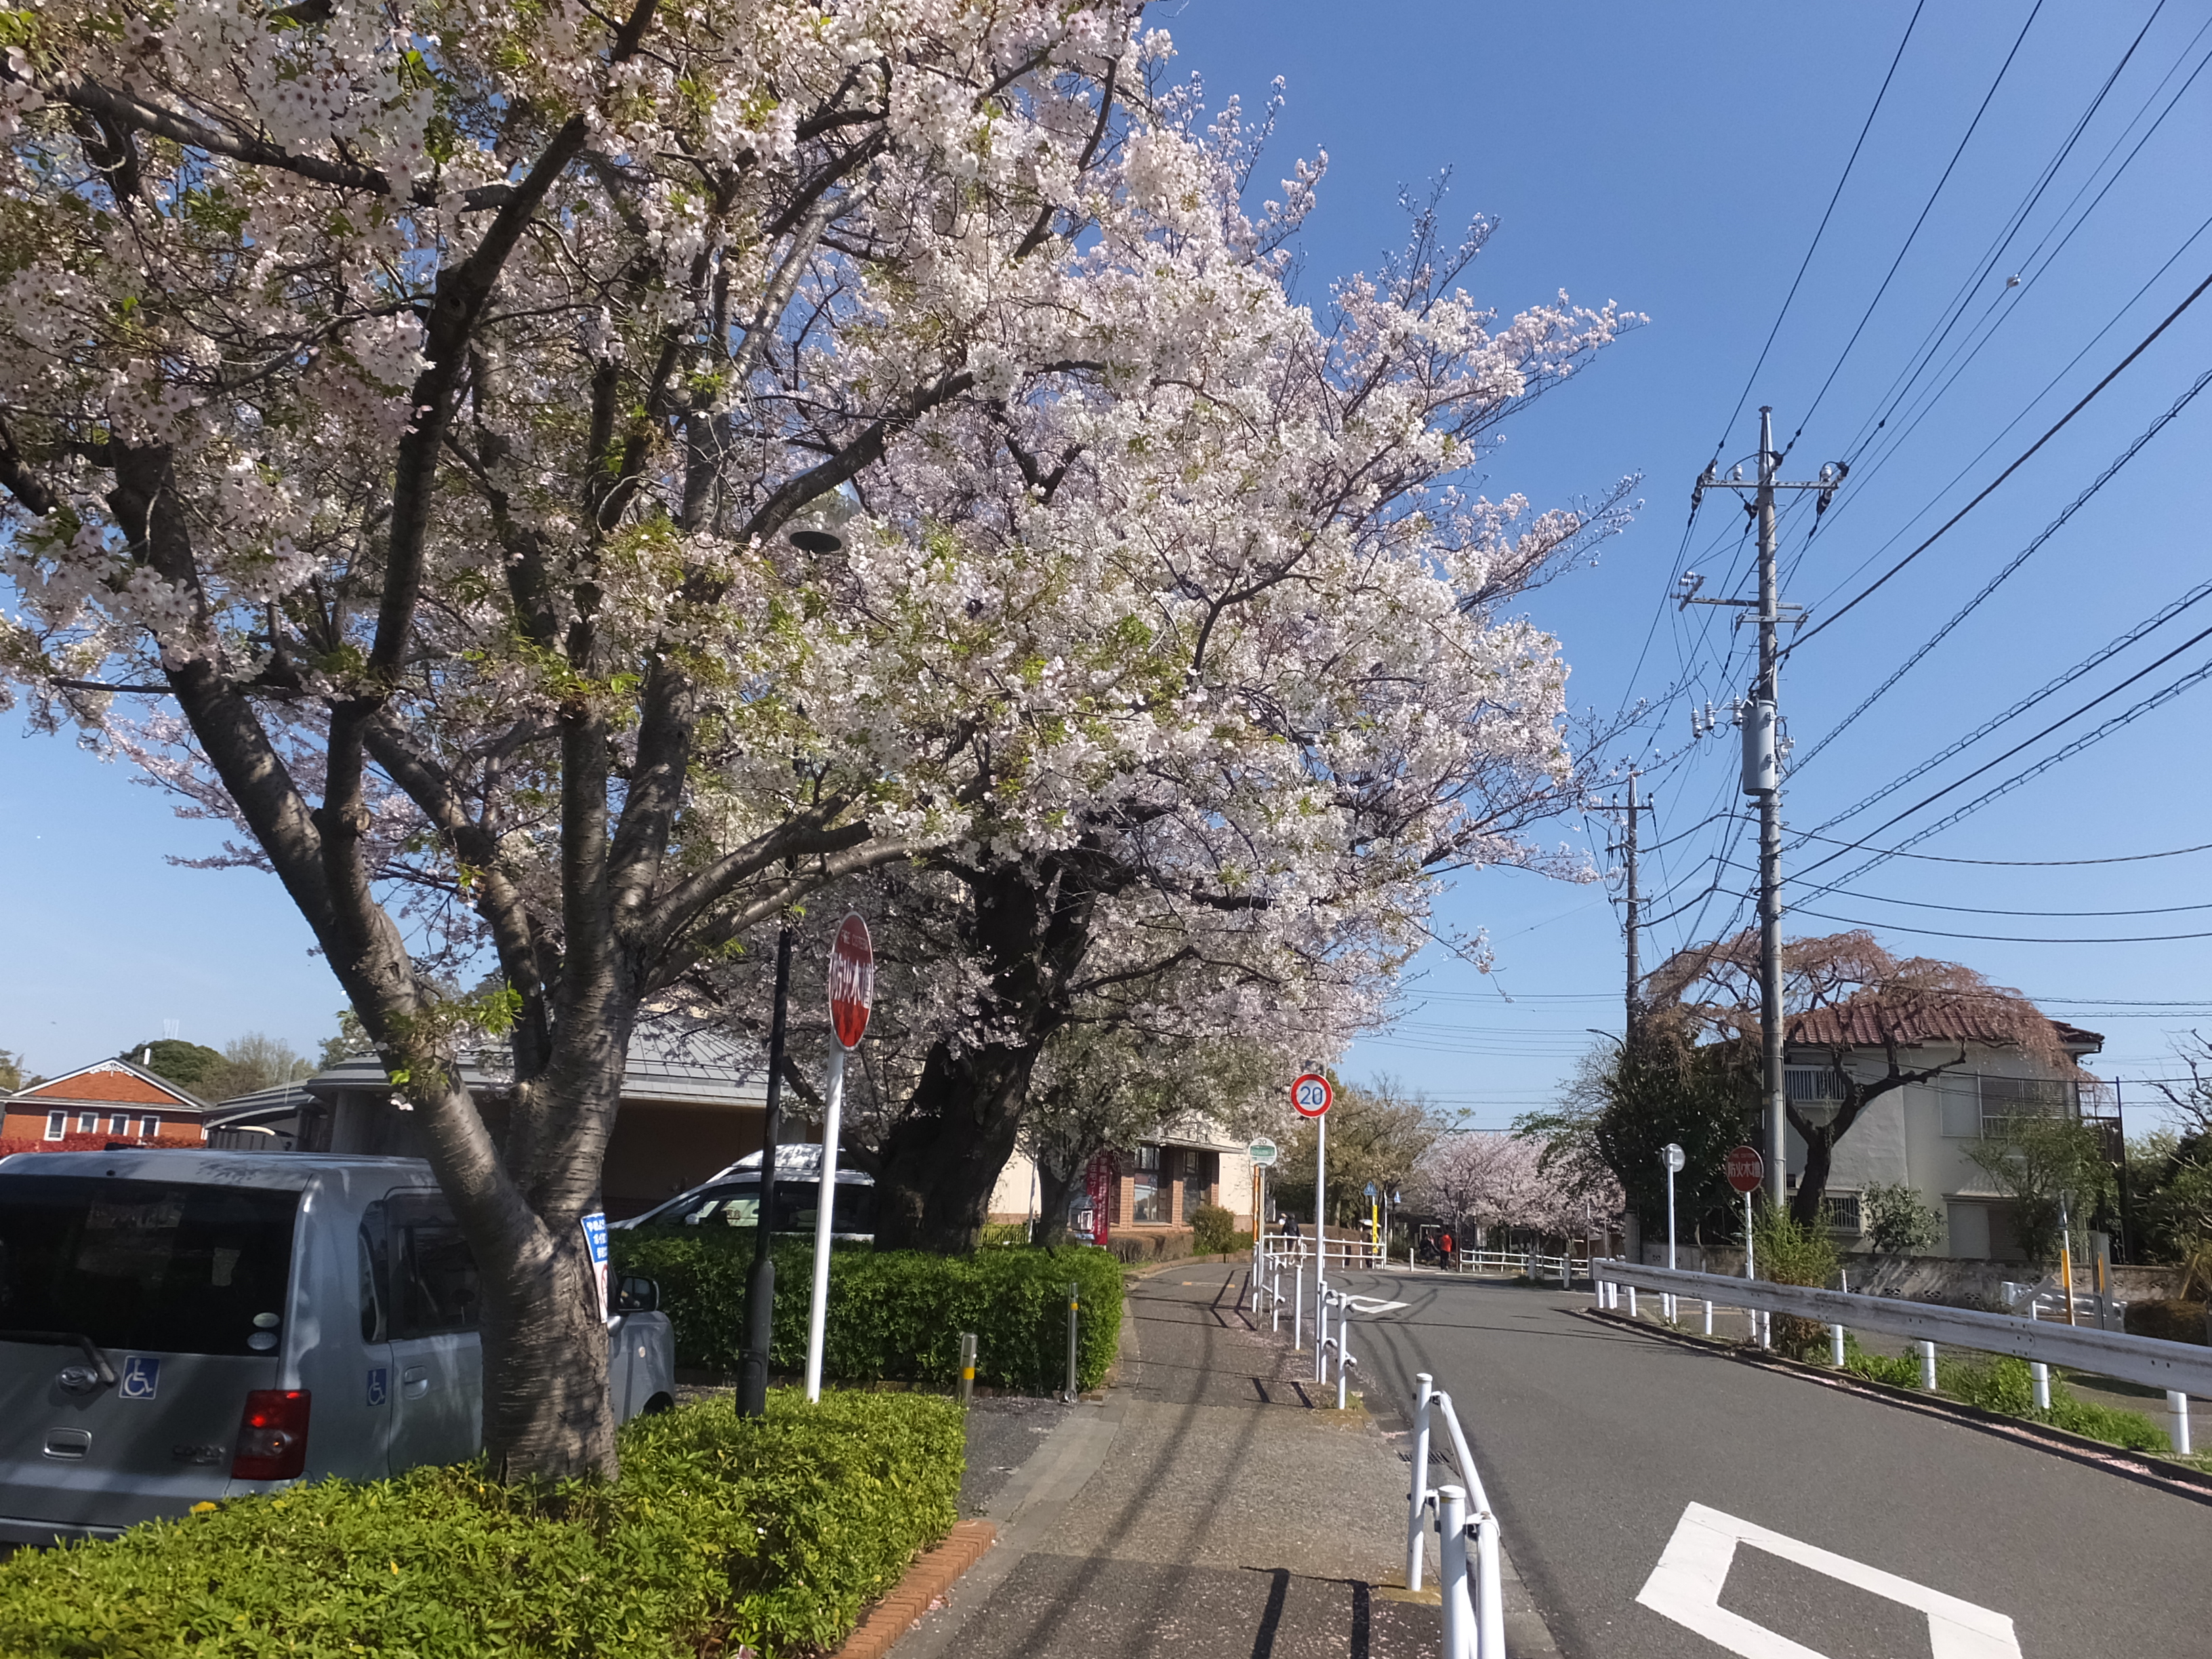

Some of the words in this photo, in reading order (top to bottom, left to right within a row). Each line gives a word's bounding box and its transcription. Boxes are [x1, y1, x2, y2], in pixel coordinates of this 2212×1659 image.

[832, 952, 871, 1009] 防火水槽
[1300, 1086, 1323, 1105] 20
